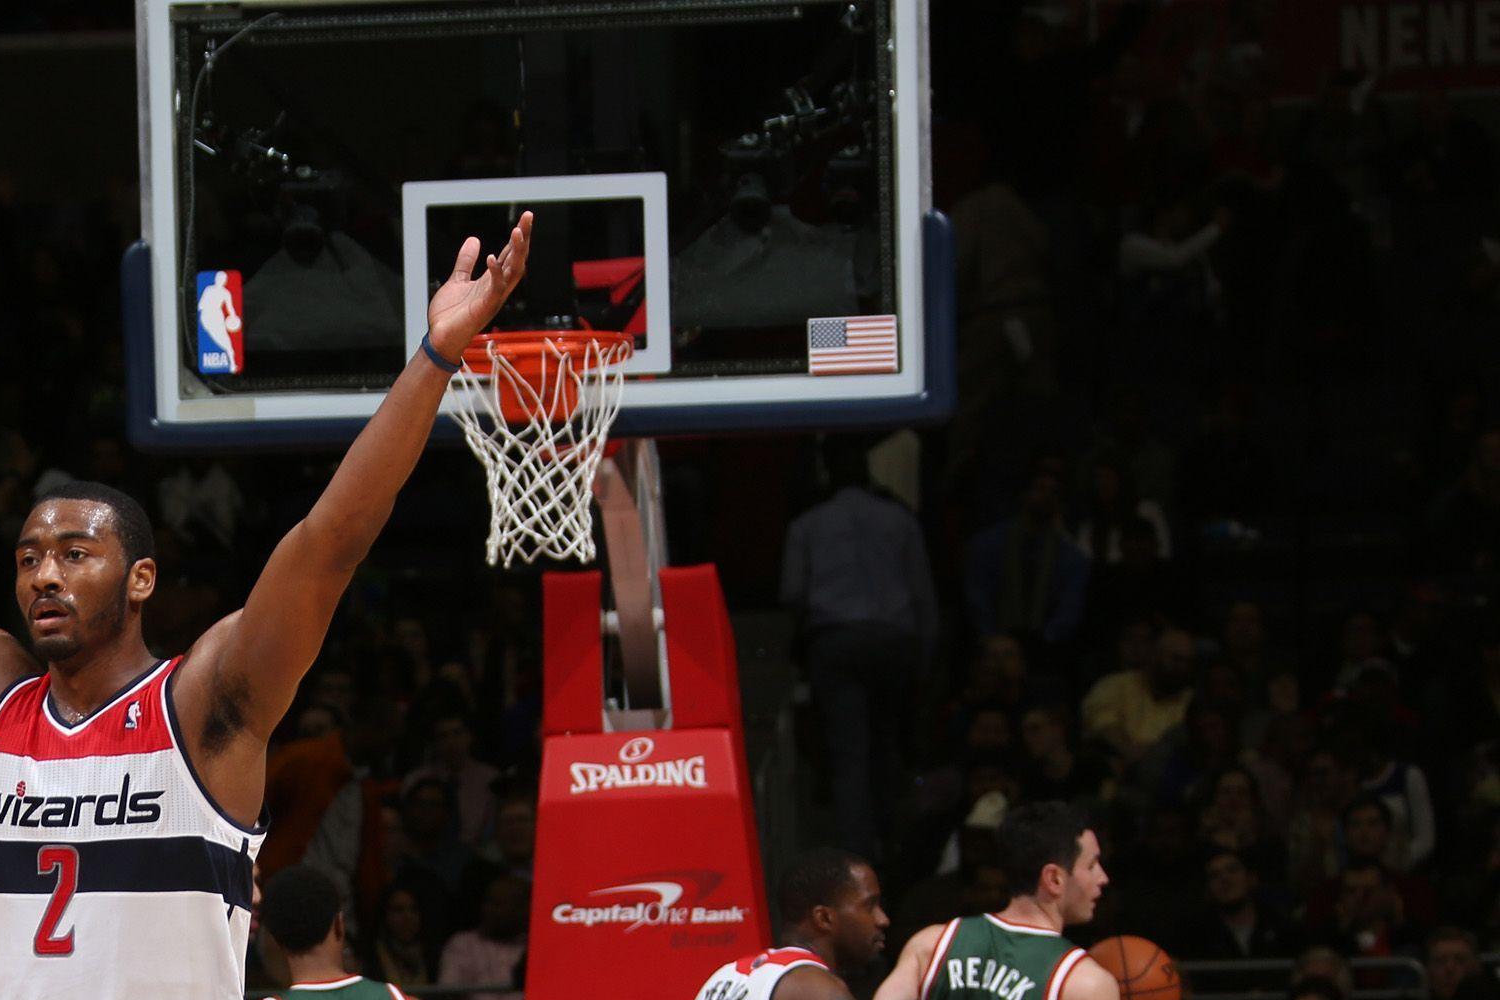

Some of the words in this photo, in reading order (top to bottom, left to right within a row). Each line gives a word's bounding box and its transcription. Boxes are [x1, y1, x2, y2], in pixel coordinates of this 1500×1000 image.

[202, 351, 229, 369] NBA
[569, 755, 708, 795] SPALDING
[32, 844, 80, 958] 2
[691, 905, 745, 924] Bank
